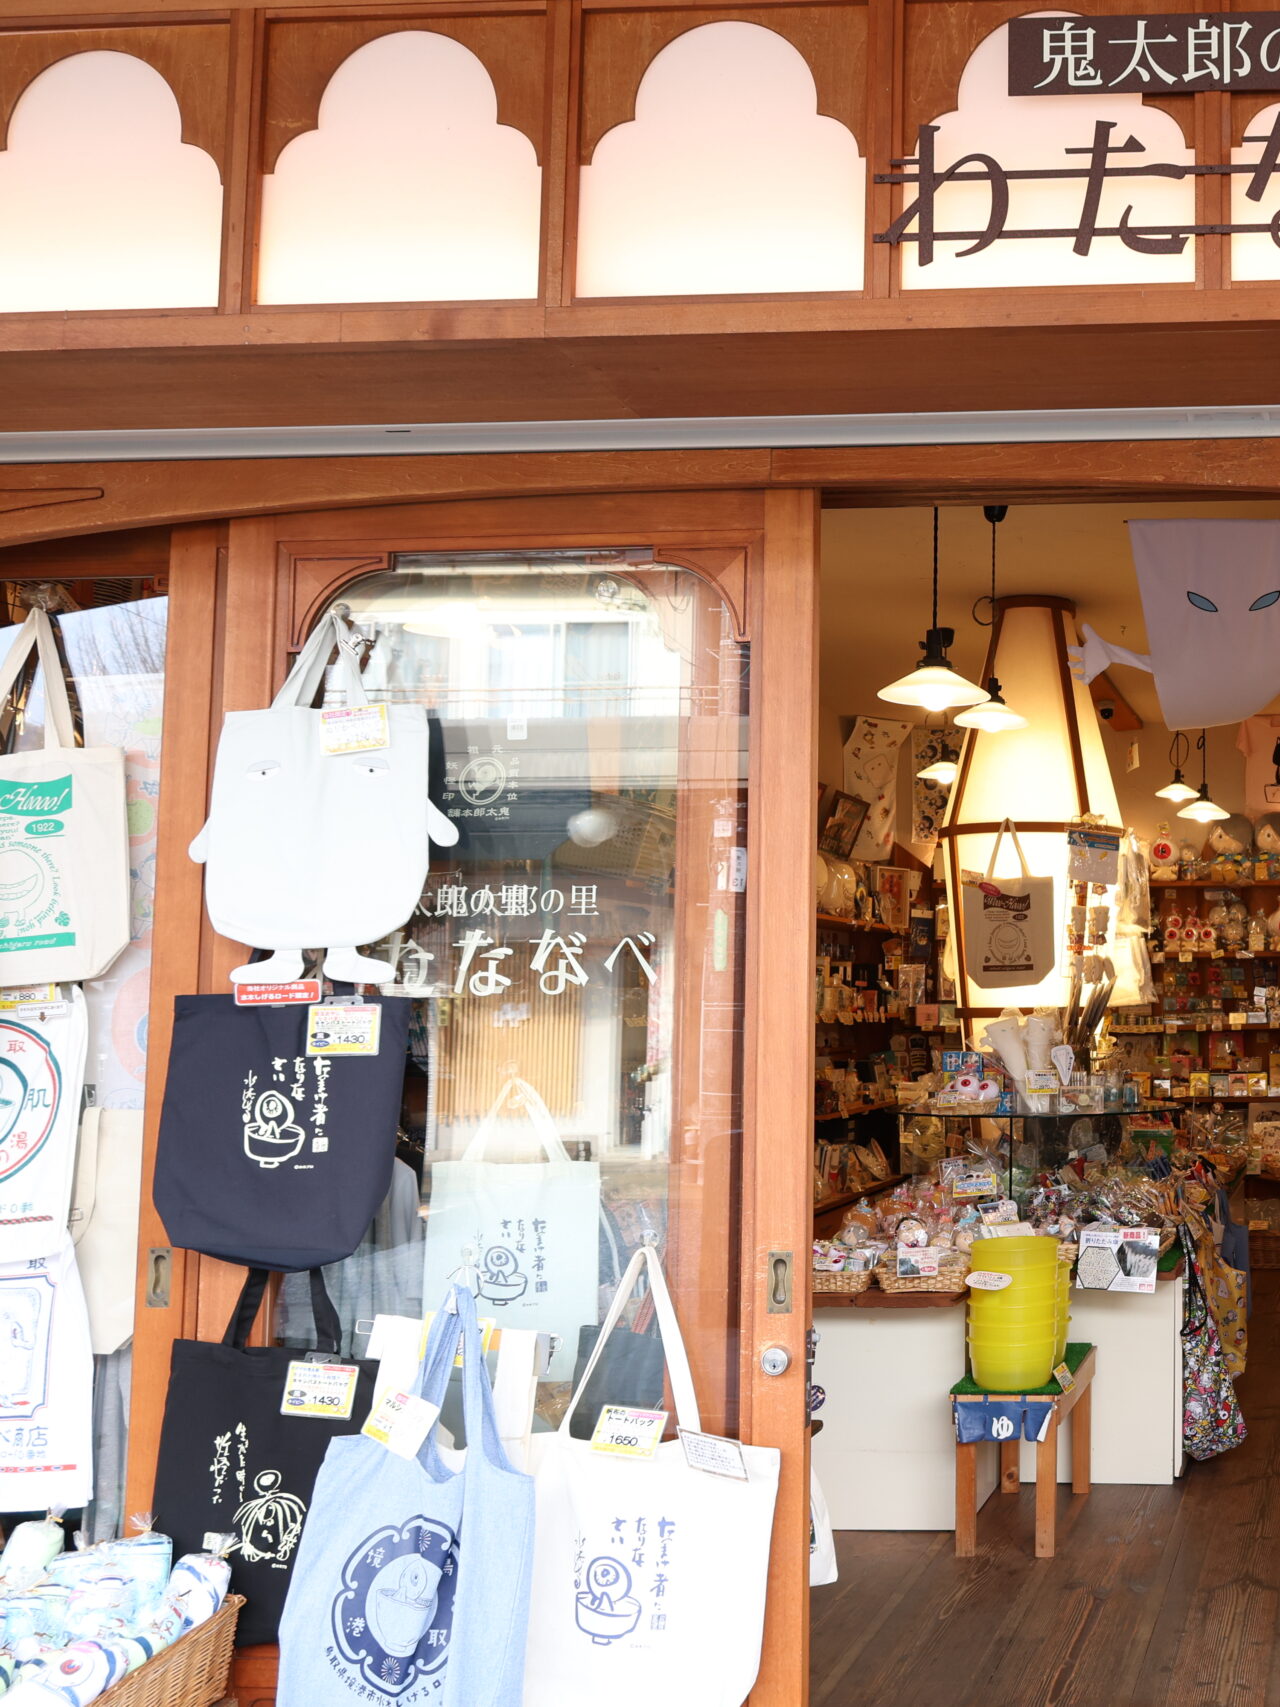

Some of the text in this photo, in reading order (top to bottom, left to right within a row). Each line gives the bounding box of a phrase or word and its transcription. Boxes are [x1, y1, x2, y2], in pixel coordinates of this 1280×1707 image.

[32, 822, 56, 832] 1922
[606, 1414, 655, 1427] トートバッグ
[367, 1547, 386, 1569] 境
[346, 1616, 366, 1637] 港
[427, 1628, 448, 1648] 取
